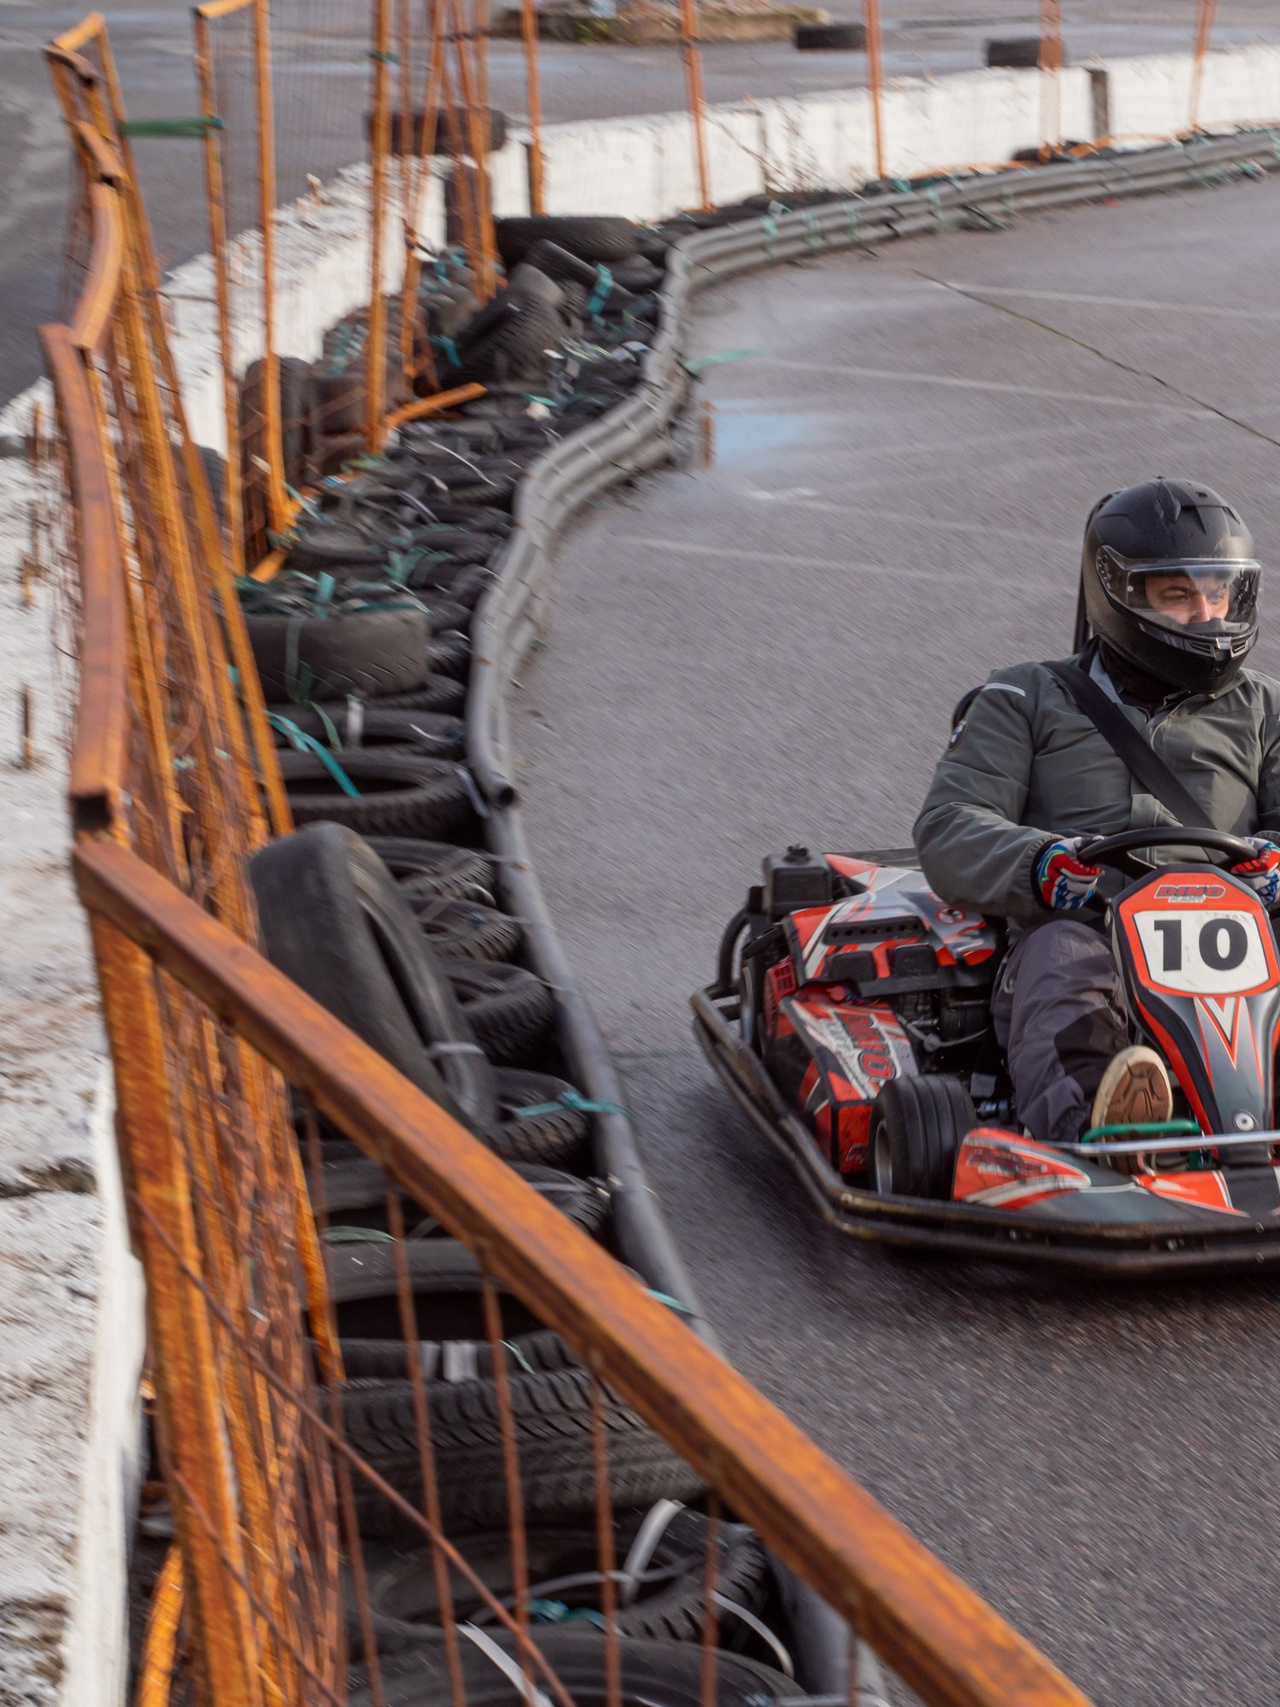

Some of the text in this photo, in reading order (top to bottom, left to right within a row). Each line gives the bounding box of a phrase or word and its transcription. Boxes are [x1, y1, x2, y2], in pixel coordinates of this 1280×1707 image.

[1155, 885, 1225, 899] DINO
[1154, 918, 1248, 972] 10
[834, 1011, 895, 1081] DINO
